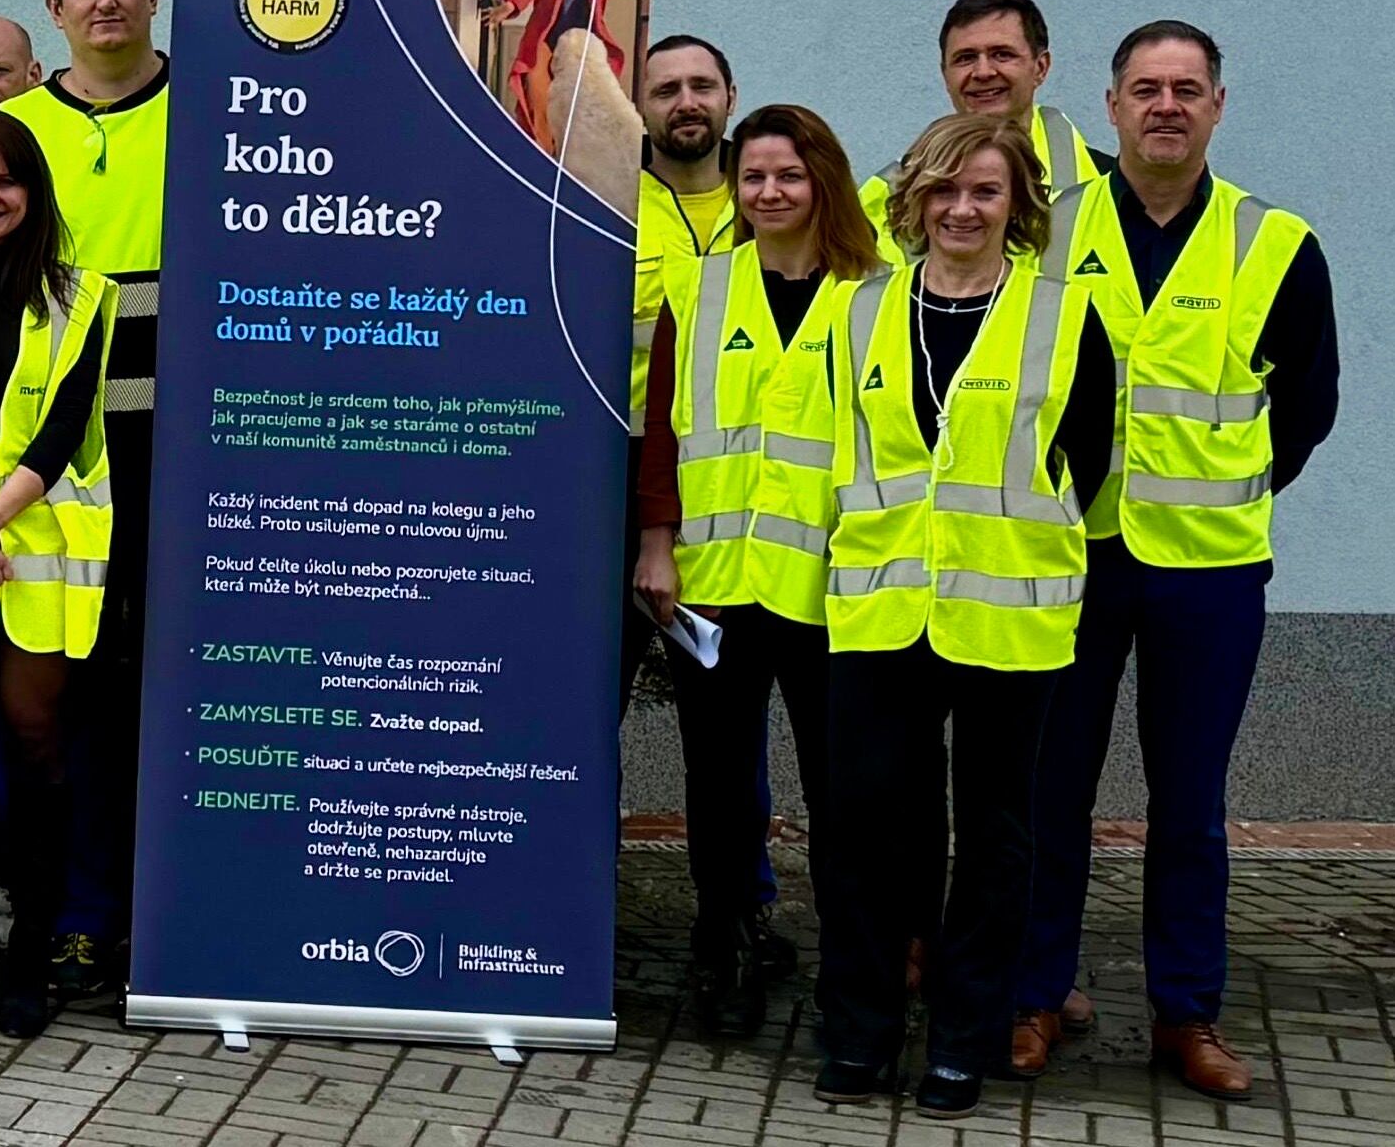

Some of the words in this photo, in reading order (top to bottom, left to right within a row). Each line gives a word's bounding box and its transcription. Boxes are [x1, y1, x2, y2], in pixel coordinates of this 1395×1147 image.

[262, 0, 319, 16] HARM
[228, 77, 307, 116] Pro
[224, 133, 333, 175] koho
[222, 198, 268, 231] to
[282, 194, 442, 238] děláte?
[218, 281, 341, 308] Dostaňte
[350, 292, 380, 309] se
[388, 286, 469, 320] každý
[477, 290, 527, 315] den
[217, 316, 292, 341] domů
[300, 326, 316, 342] v
[324, 320, 439, 350] pořádku
[214, 388, 305, 406] Bezpečnost
[308, 392, 323, 409] je
[329, 394, 387, 408] srdcem
[437, 396, 461, 414] jak
[211, 409, 234, 426] jak
[240, 412, 321, 429] pracujeme
[327, 417, 336, 428] a
[340, 414, 365, 431] jak
[370, 419, 388, 430] se
[394, 416, 459, 433] staráme
[464, 423, 474, 433] o
[479, 420, 536, 436] ostatní
[211, 434, 221, 444] v
[226, 431, 259, 446] naší
[263, 433, 336, 449] komunitě
[341, 436, 447, 453] zaměstnanců
[462, 440, 511, 456] doma.
[209, 493, 255, 511] Každý
[259, 494, 319, 511] incident
[324, 497, 348, 512] má
[353, 498, 403, 516] dopad
[408, 504, 426, 515] na
[432, 501, 483, 520] kolegu
[488, 507, 497, 518] a
[500, 504, 535, 522] jeho
[208, 513, 255, 529] blízké.
[260, 515, 301, 531] Proto
[306, 518, 380, 536] usilujeme
[385, 524, 395, 535] o
[400, 522, 461, 537] nulovou
[466, 523, 507, 541] újmu.
[206, 555, 254, 571] Pokud
[258, 557, 300, 573] čelíte
[304, 558, 346, 575] úkolu
[352, 562, 391, 577] nebo
[396, 566, 477, 583] pozorujete
[205, 576, 244, 592] která
[249, 578, 290, 594] může
[295, 579, 320, 597] být
[202, 643, 317, 664] ZASTAVTE.
[322, 651, 382, 670] Věnujte
[387, 654, 413, 669] čas
[418, 657, 502, 674] rozpoznání
[321, 675, 444, 692] potencionálních
[449, 679, 483, 693] rizik.
[200, 703, 324, 725] ZAMYSLETE
[331, 709, 362, 727] SE.
[370, 713, 424, 730] Zvažte
[429, 716, 483, 734] dopad.
[199, 745, 299, 767] POSUĎTE
[304, 754, 350, 770] situaci
[354, 760, 363, 771] a
[368, 758, 415, 774] určete
[418, 760, 527, 781] nejbezpečnější
[530, 764, 579, 781] řešení.
[195, 791, 300, 811] JEDNEJTE.
[309, 798, 389, 818] Používejte
[394, 802, 456, 820] správné
[308, 819, 382, 839] dodržujte
[458, 827, 513, 843] mluvte
[386, 845, 486, 865] nehazardujte
[304, 865, 313, 875] a
[318, 862, 359, 878] držte
[364, 868, 382, 879] se
[387, 867, 454, 882] pravidel.
[302, 938, 369, 962] orbia
[459, 944, 522, 962] Building
[525, 948, 537, 960] &
[459, 956, 564, 975] Infrastructure
